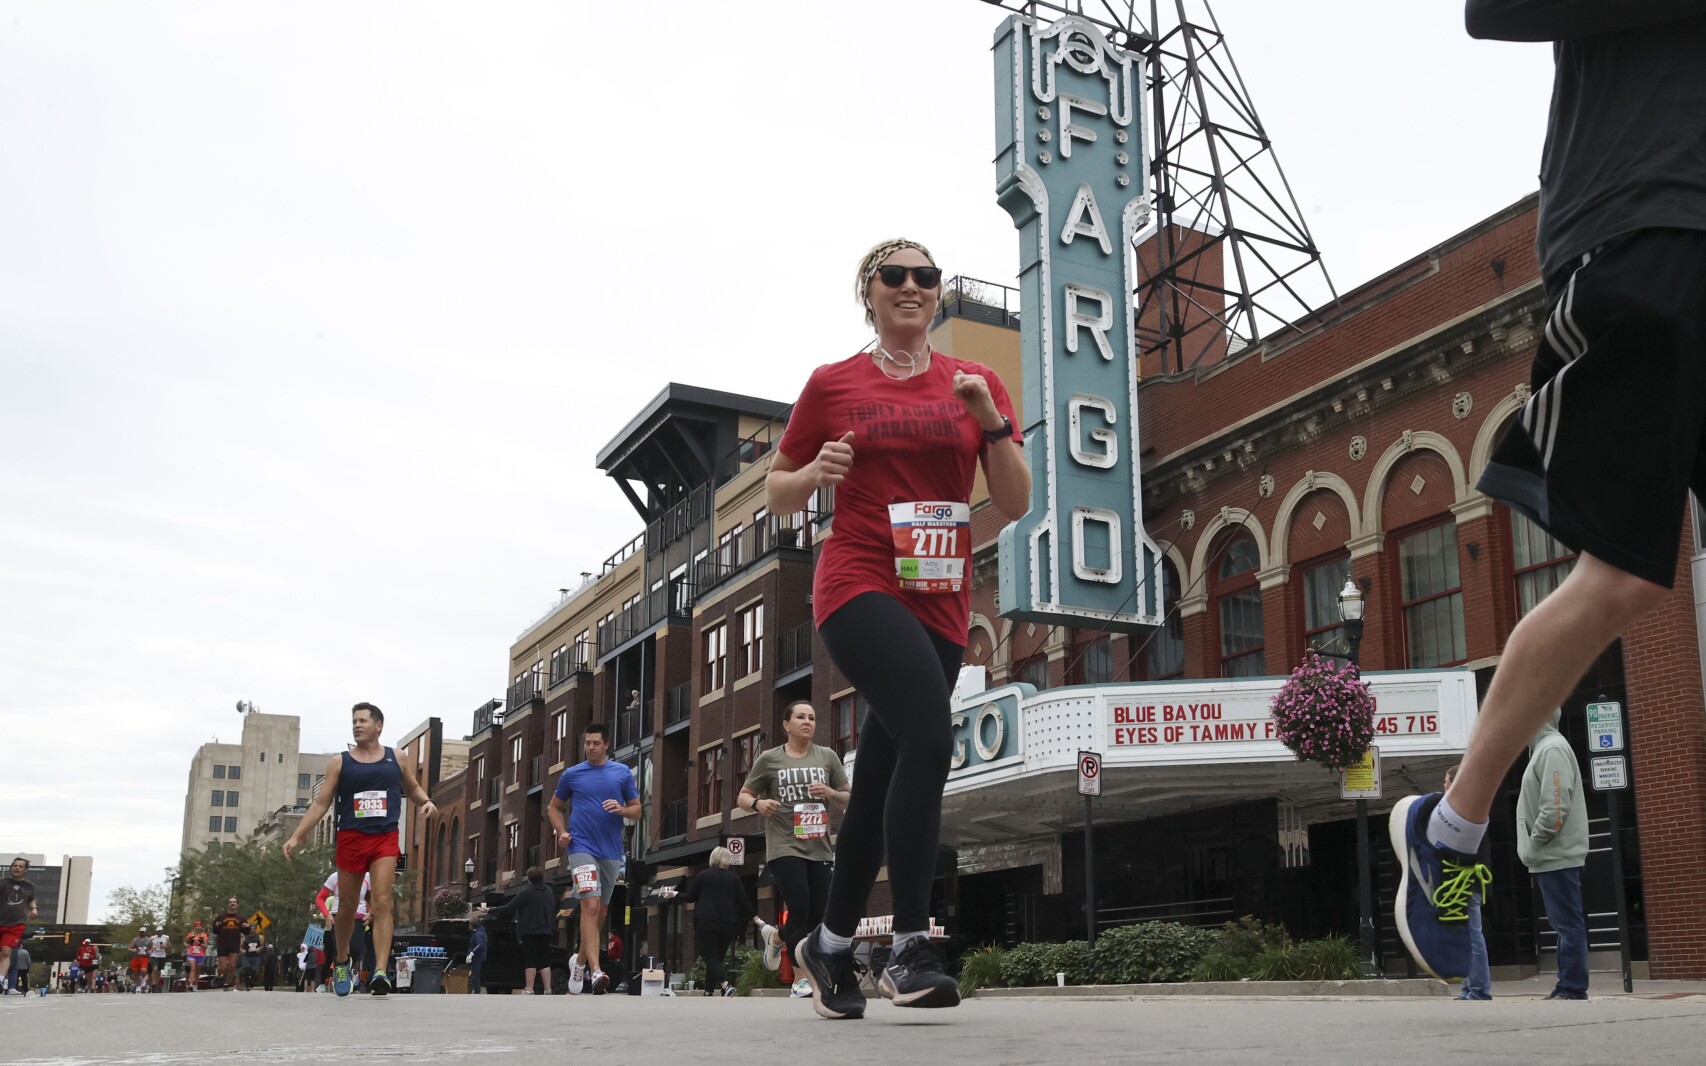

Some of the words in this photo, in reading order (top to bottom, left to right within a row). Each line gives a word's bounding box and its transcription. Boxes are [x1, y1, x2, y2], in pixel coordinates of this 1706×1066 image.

[1057, 93, 1123, 584] FARGO
[914, 503, 952, 520] Fargo
[911, 528, 957, 556] 2771
[1114, 706, 1156, 724] BLUE
[1163, 703, 1222, 722] BAYOU
[1588, 708, 1598, 718] 90
[1115, 727, 1158, 745] EYES
[1164, 726, 1184, 743] OF
[1190, 723, 1257, 742] TAMMY
[778, 767, 826, 785] PITTER
[358, 800, 384, 810] 2033
[800, 814, 823, 825] 2272
